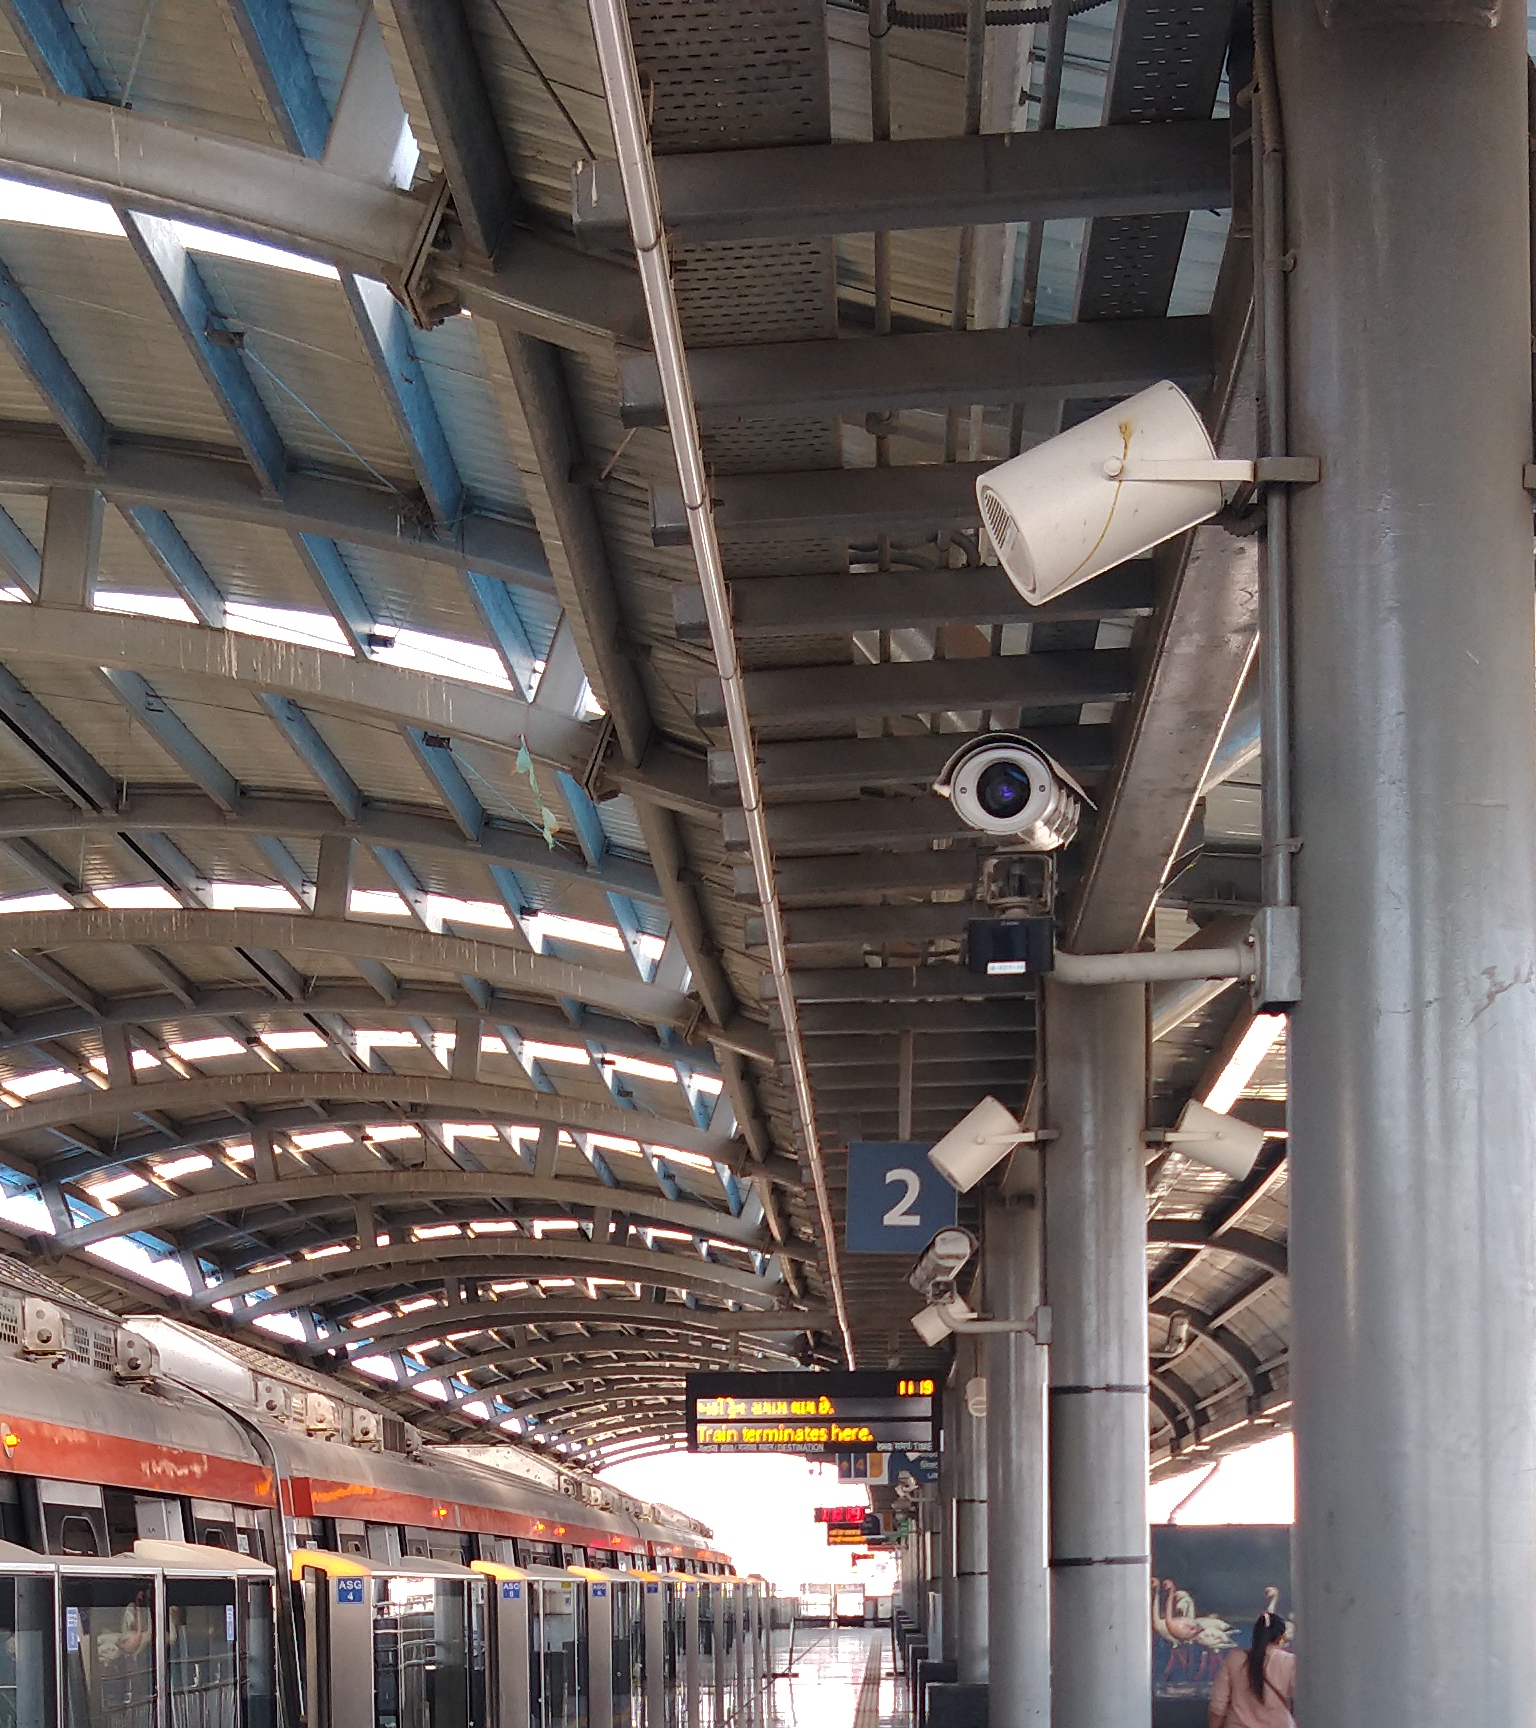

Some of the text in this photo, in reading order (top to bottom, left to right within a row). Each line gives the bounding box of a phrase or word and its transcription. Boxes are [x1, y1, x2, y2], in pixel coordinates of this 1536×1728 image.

[882, 1168, 921, 1226] 2
[697, 1422, 874, 1443] Train terminates here.
[339, 1580, 362, 1590] ASG
[347, 1591, 354, 1601] 4
